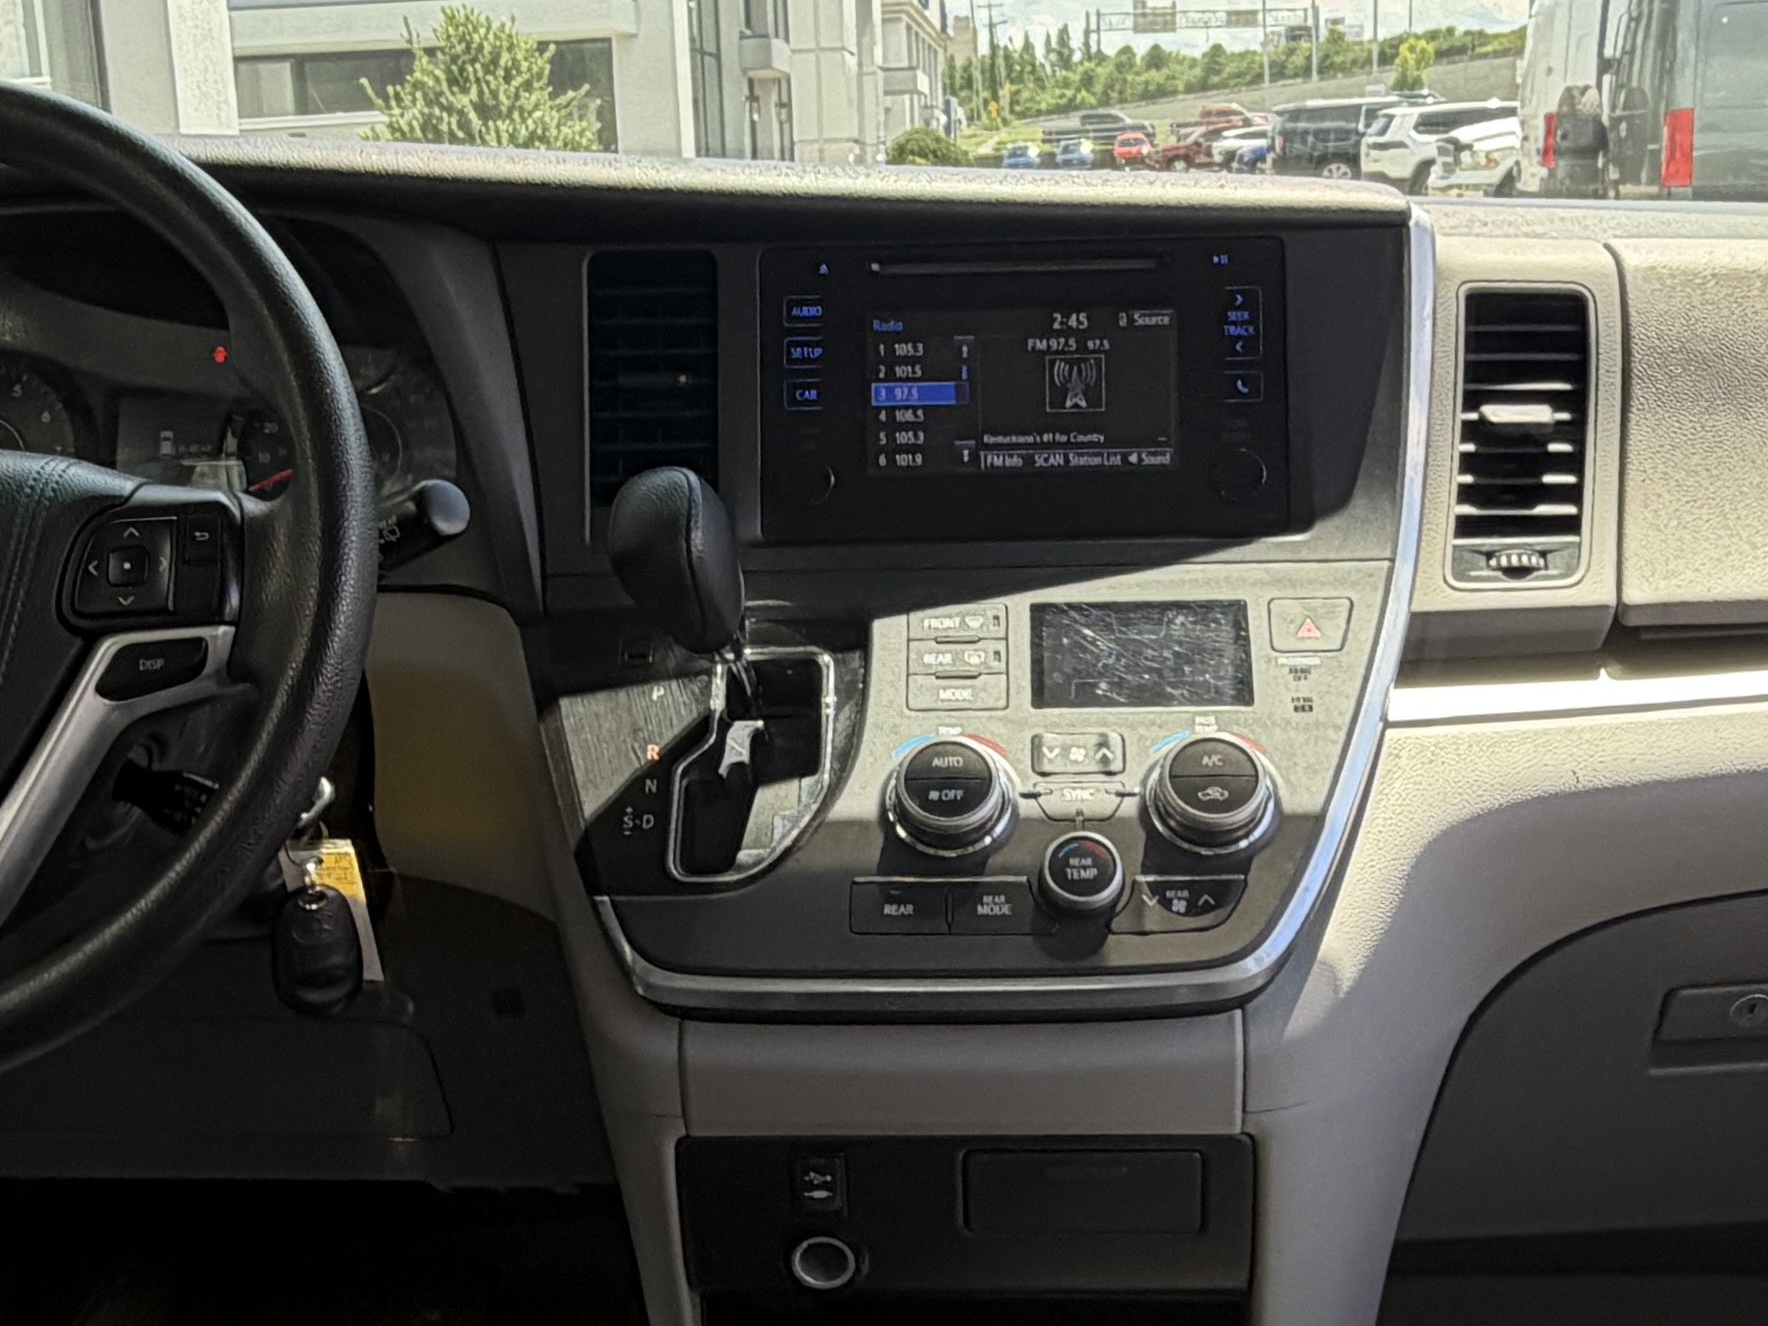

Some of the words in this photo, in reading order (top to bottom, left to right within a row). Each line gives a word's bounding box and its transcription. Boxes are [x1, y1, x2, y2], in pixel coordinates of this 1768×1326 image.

[791, 306, 823, 318] AUDIO
[872, 319, 905, 333] Radio
[1052, 312, 1088, 329] 2:45
[1133, 313, 1171, 326] Source
[879, 344, 886, 357] 1
[894, 342, 924, 357] 105.3
[1027, 338, 1047, 351] FM
[1049, 338, 1077, 352] 97.5
[878, 365, 887, 379] 2
[894, 364, 923, 379] 101.5
[795, 389, 819, 401] CAR
[878, 387, 887, 401] 3
[893, 386, 919, 401] 97.5
[878, 409, 887, 423] 4
[878, 431, 887, 445] 5
[878, 453, 887, 467] 6
[895, 453, 924, 467] 101.9
[986, 453, 1004, 467] FM
[1004, 452, 1024, 467] Info
[1034, 452, 1064, 467] SCAN
[1068, 452, 1103, 467] Station
[1103, 452, 1122, 466] List
[1141, 451, 1172, 466] Sound
[923, 616, 960, 630] FRONT
[139, 657, 164, 671] DISP
[923, 652, 953, 665] REAR
[651, 685, 665, 702] P
[938, 687, 974, 701] MODE
[646, 744, 660, 761] R
[932, 757, 964, 768] AUTO
[1201, 754, 1225, 767] A/C
[644, 778, 658, 794] N
[941, 789, 965, 801] OFF
[1061, 788, 1096, 801] SYNC
[1069, 857, 1094, 867] REAR
[1065, 867, 1099, 882] TEMP
[883, 904, 915, 917] REAR
[977, 903, 1013, 917] MODE
